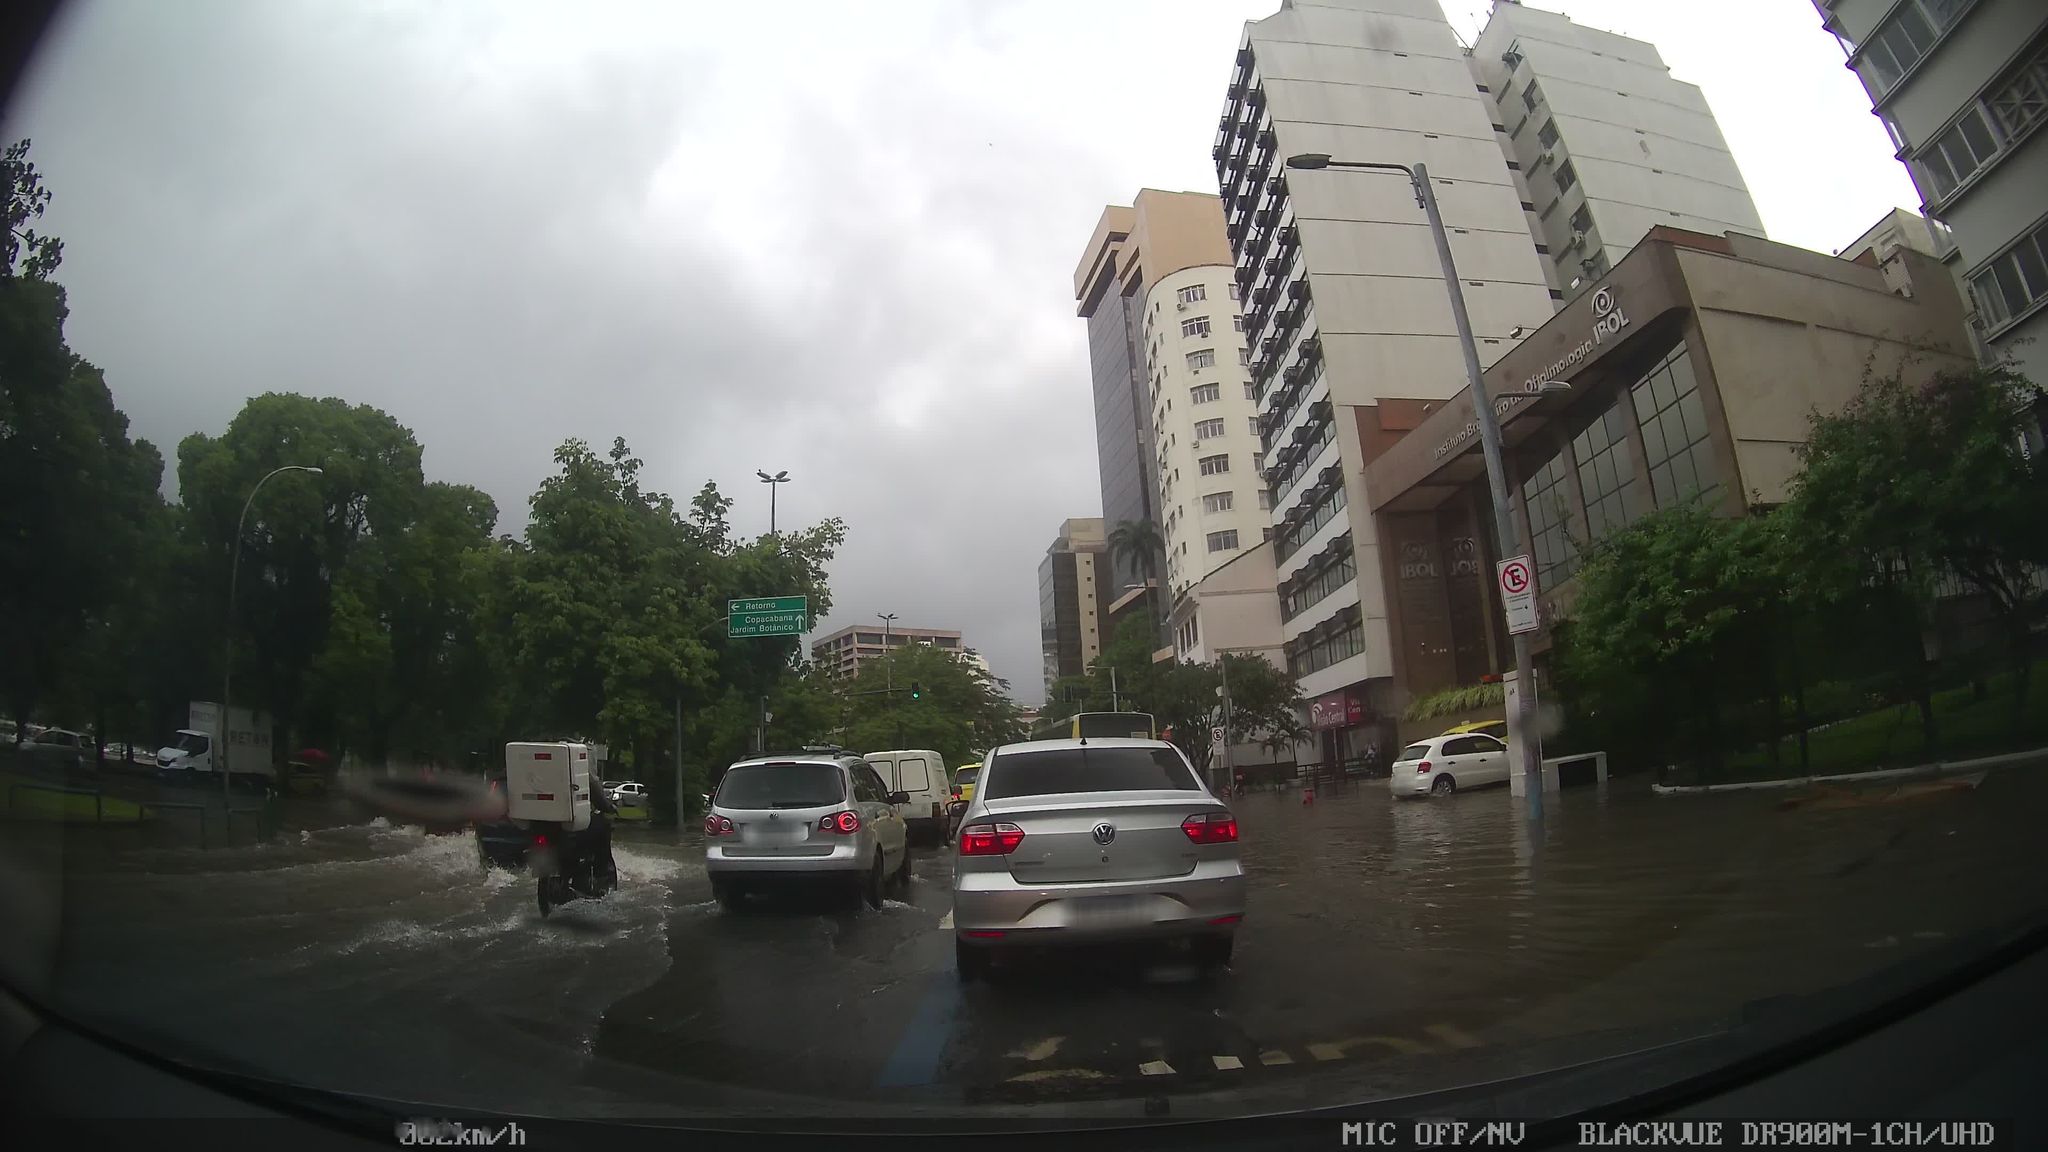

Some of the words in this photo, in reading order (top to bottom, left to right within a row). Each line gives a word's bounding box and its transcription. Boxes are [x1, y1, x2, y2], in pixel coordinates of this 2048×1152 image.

[745, 602, 776, 610] Retorno
[745, 615, 793, 624] Copacabana
[730, 626, 756, 634] Jardim
[759, 624, 794, 632] Botânico
